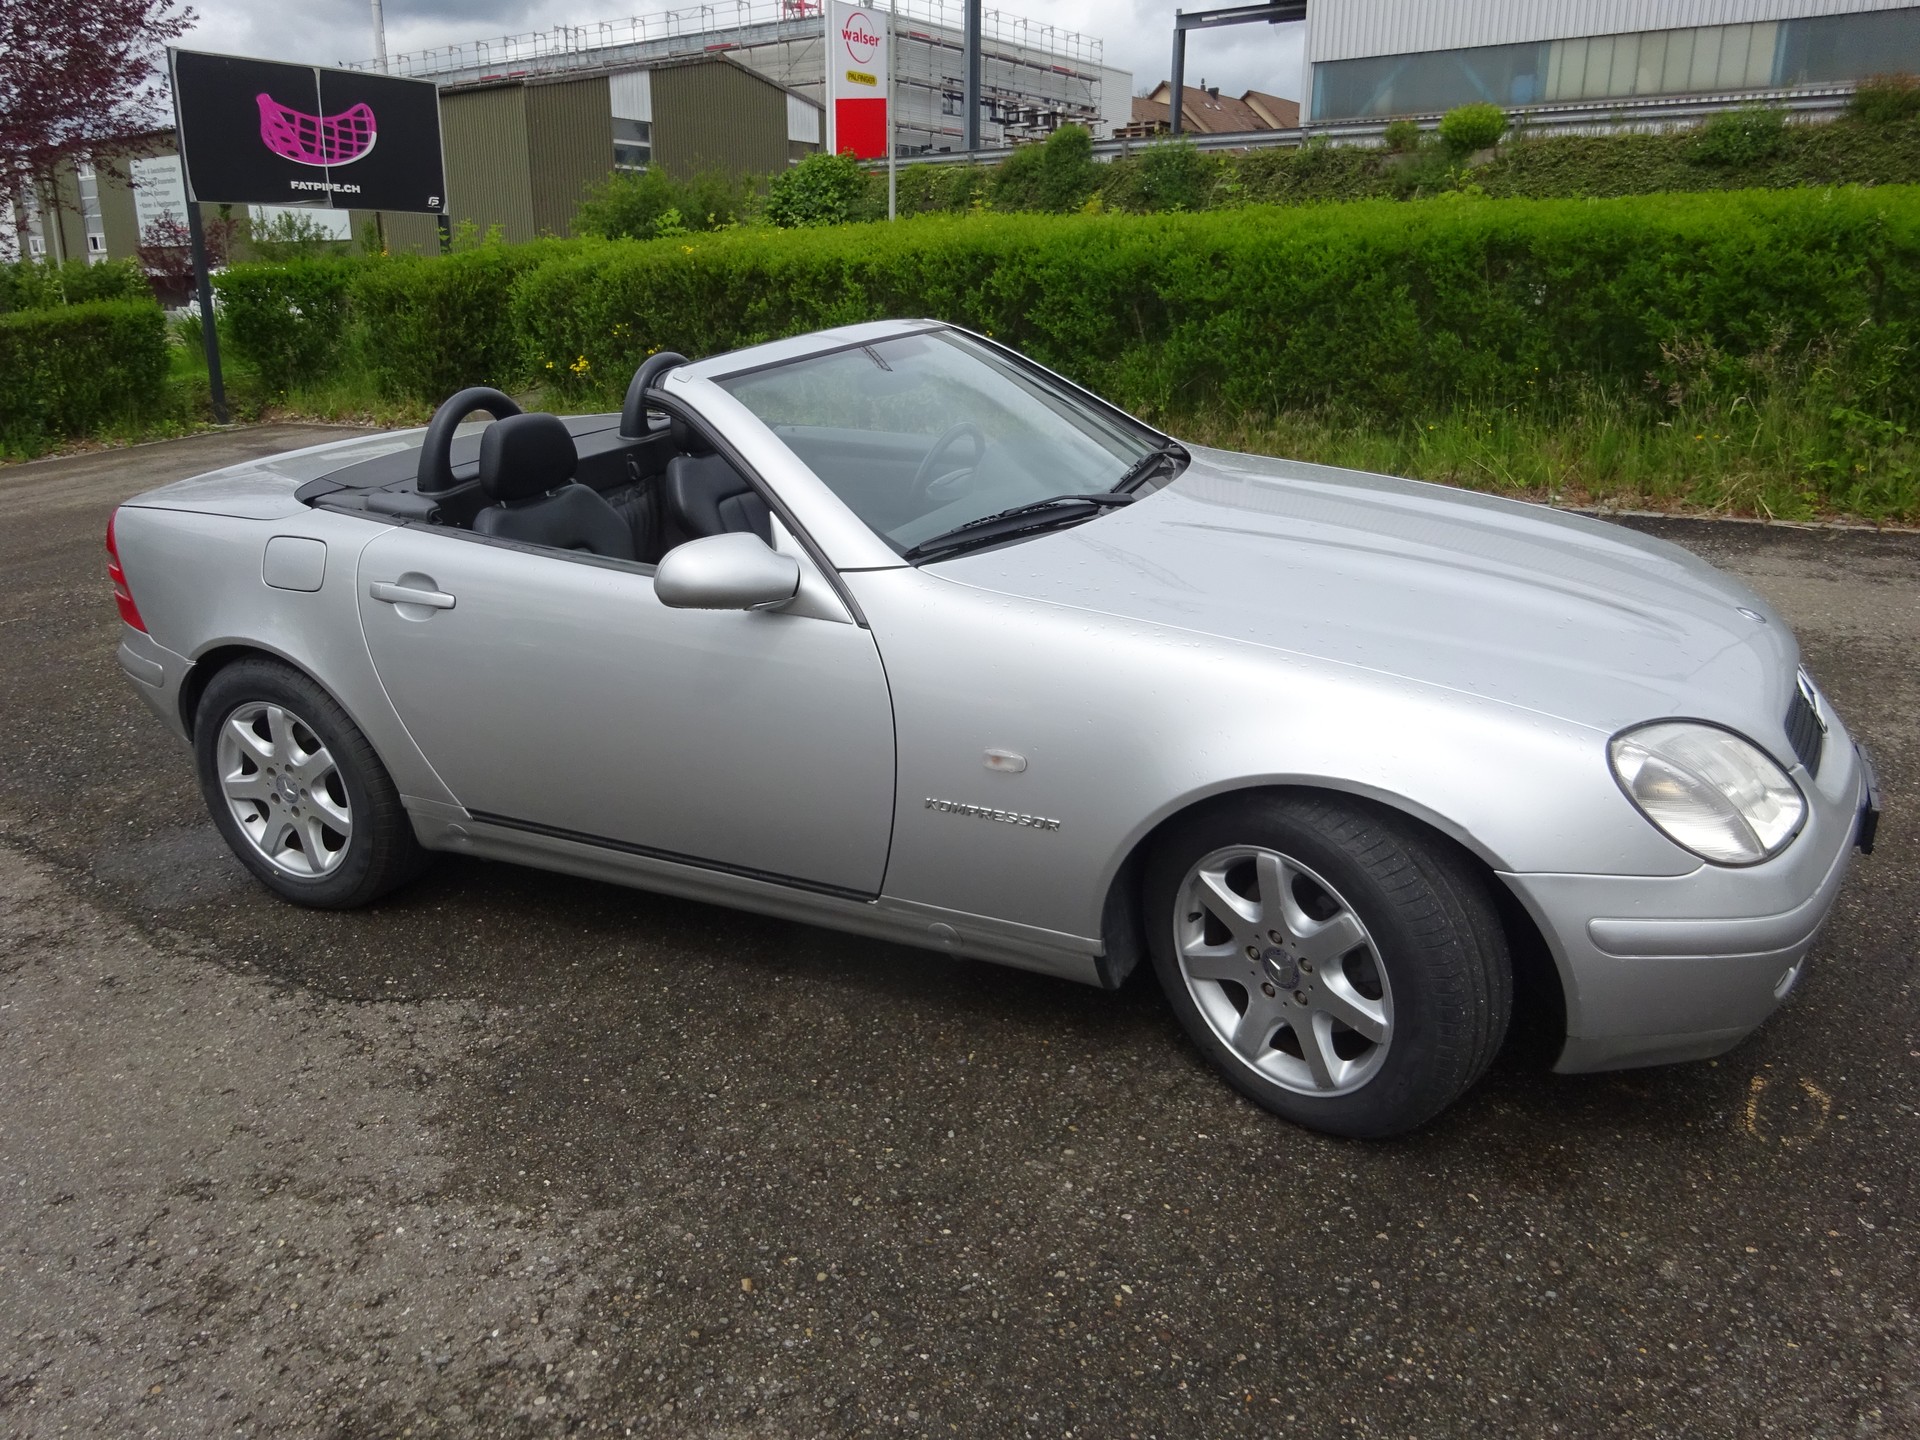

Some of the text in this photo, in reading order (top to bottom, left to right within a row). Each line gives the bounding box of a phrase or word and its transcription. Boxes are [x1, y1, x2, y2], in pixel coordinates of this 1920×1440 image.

[842, 27, 880, 47] walser
[290, 181, 361, 194] FATPIPE.CH
[924, 798, 1061, 832] KOMPRESSOR
